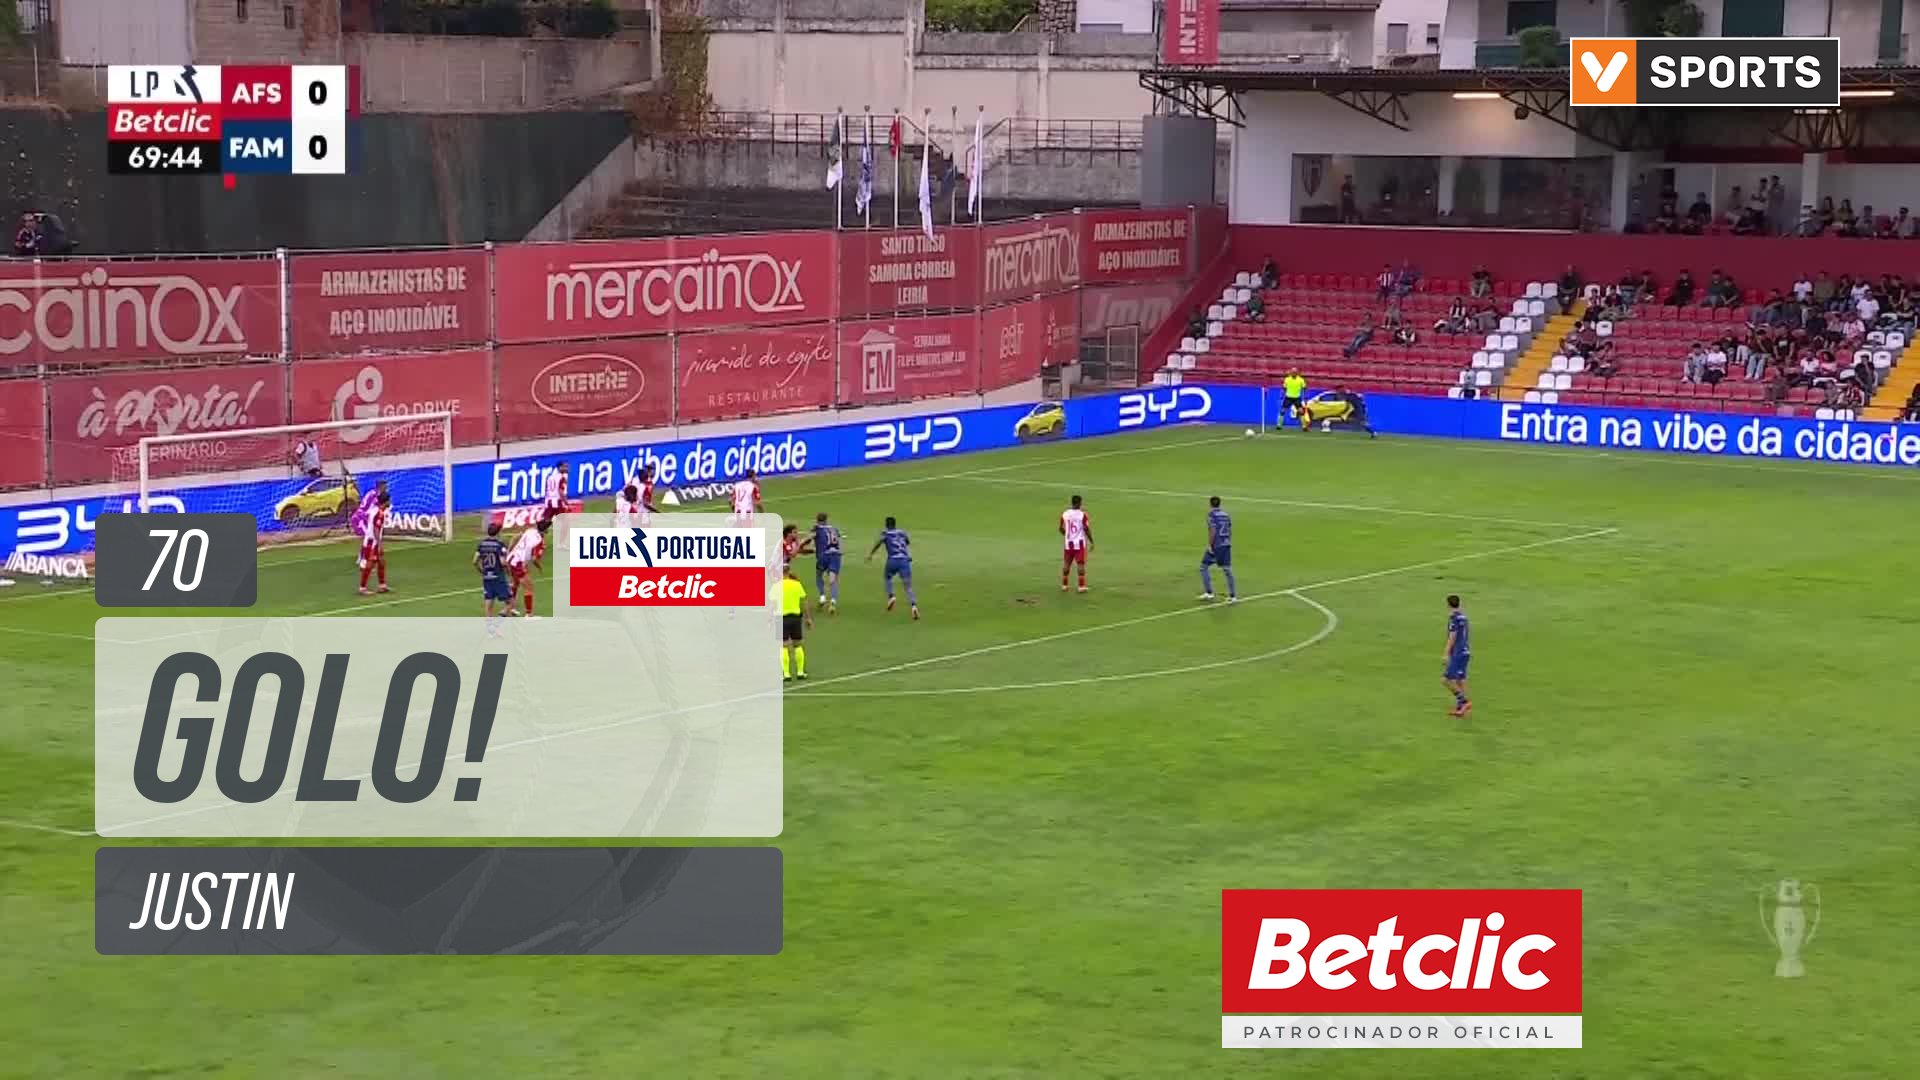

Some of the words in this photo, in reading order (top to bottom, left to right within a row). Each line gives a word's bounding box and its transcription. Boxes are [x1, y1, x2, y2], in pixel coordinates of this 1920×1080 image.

[1093, 222, 1172, 241] ARMAZENISTAS
[881, 236, 915, 256] SANTO
[320, 266, 444, 297] ARMAZENISTAS
[446, 266, 467, 290] DE
[869, 263, 913, 283] SAMORA
[914, 260, 956, 280] CORREIA
[897, 285, 928, 305] LEIRIA
[329, 309, 365, 340] AÇO
[366, 301, 460, 334] INOXIDÁVEL
[412, 399, 461, 415] DRIVE
[708, 387, 806, 408] RESTAURANTE
[1501, 404, 1588, 443] Entra
[1600, 416, 1642, 447] na
[1652, 414, 1727, 451] vibe
[1737, 418, 1782, 455] da
[1795, 420, 1920, 464] cidade
[491, 462, 568, 504] Entr
[577, 460, 613, 494] na
[620, 448, 678, 487] vibe
[683, 443, 716, 481] da
[724, 433, 807, 475] cidade
[383, 507, 442, 532] BANCA
[13, 553, 88, 578] ABANCA
